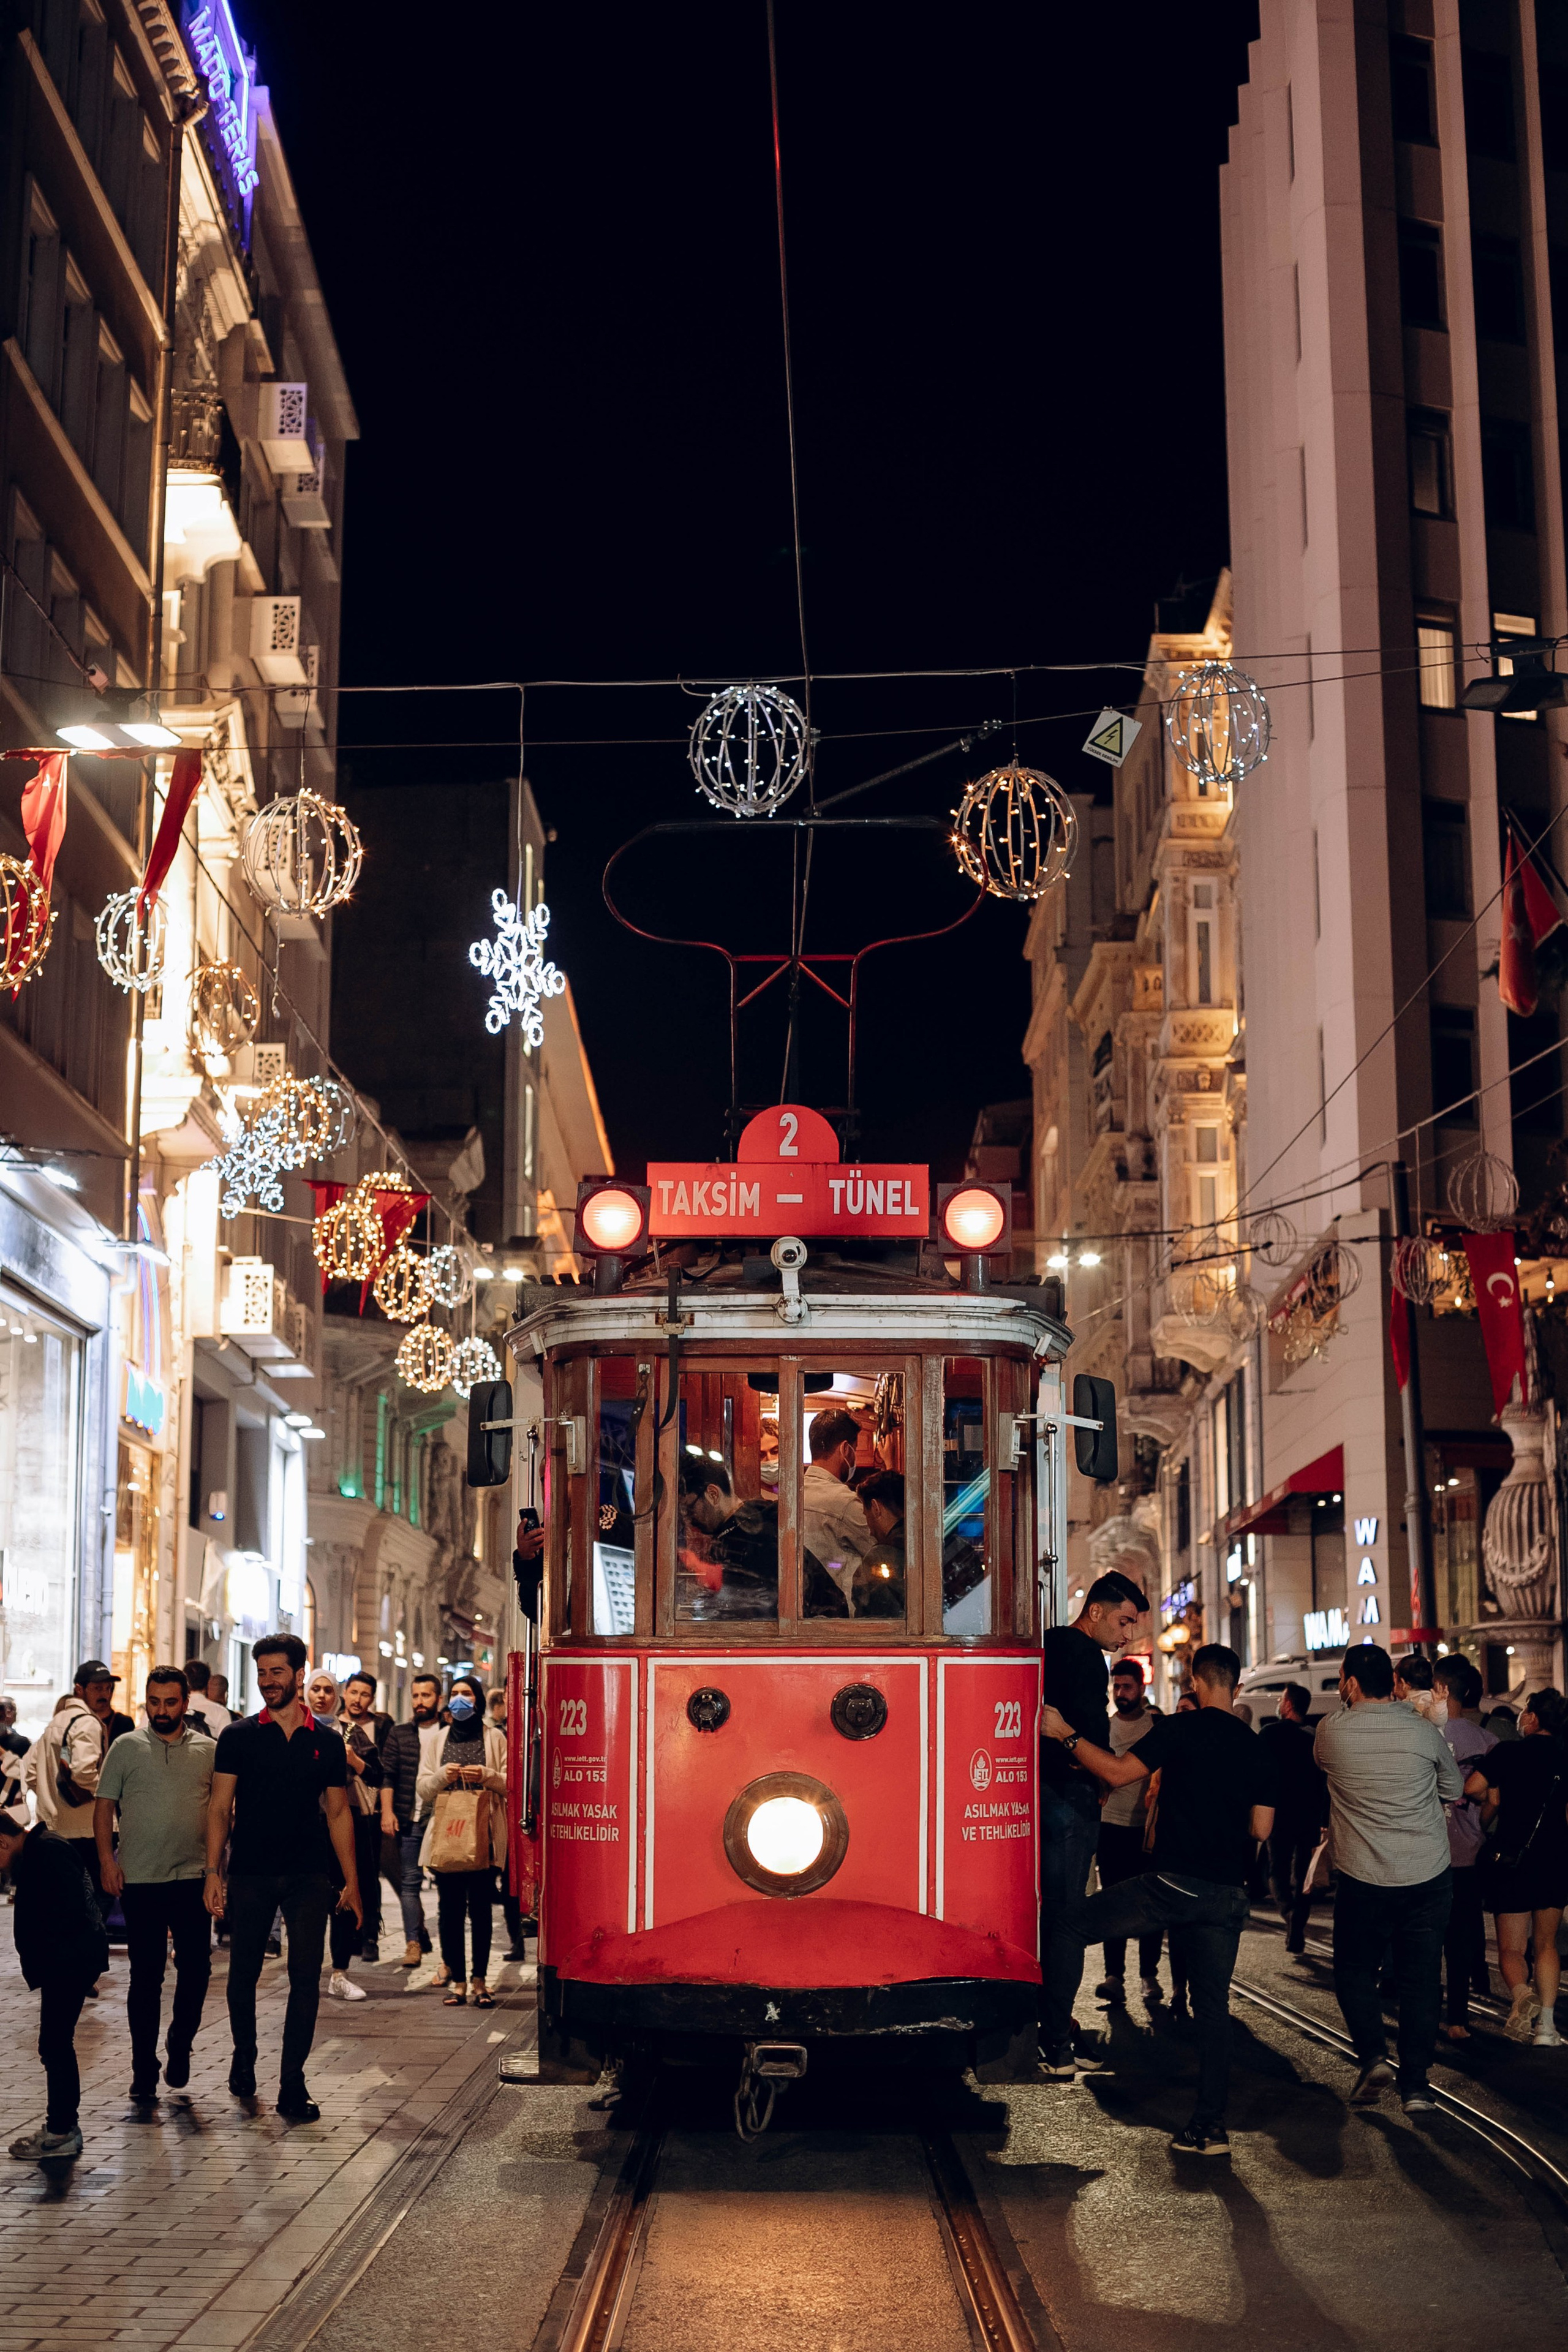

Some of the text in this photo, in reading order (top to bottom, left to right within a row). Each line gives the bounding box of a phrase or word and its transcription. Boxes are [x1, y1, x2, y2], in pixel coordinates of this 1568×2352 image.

[188, 6, 259, 197] MADO TERAS
[779, 1112, 798, 1156] 2
[658, 1172, 760, 1217] TAKSİM
[829, 1170, 919, 1215] TÜNEL
[1354, 1517, 1379, 1645] WAM
[560, 1699, 587, 1735] 223
[994, 1701, 1021, 1738] 223
[564, 1770, 607, 1782] ALO 153
[995, 1770, 1028, 1783] ALO 153
[551, 1802, 617, 1819] ASILMAK YASAK
[964, 1801, 1030, 1819] ASILMAK YASAK
[556, 1822, 619, 1841] TEHLİKELİDİR
[962, 1820, 1030, 1841] VE TEHLİKELİDİR
